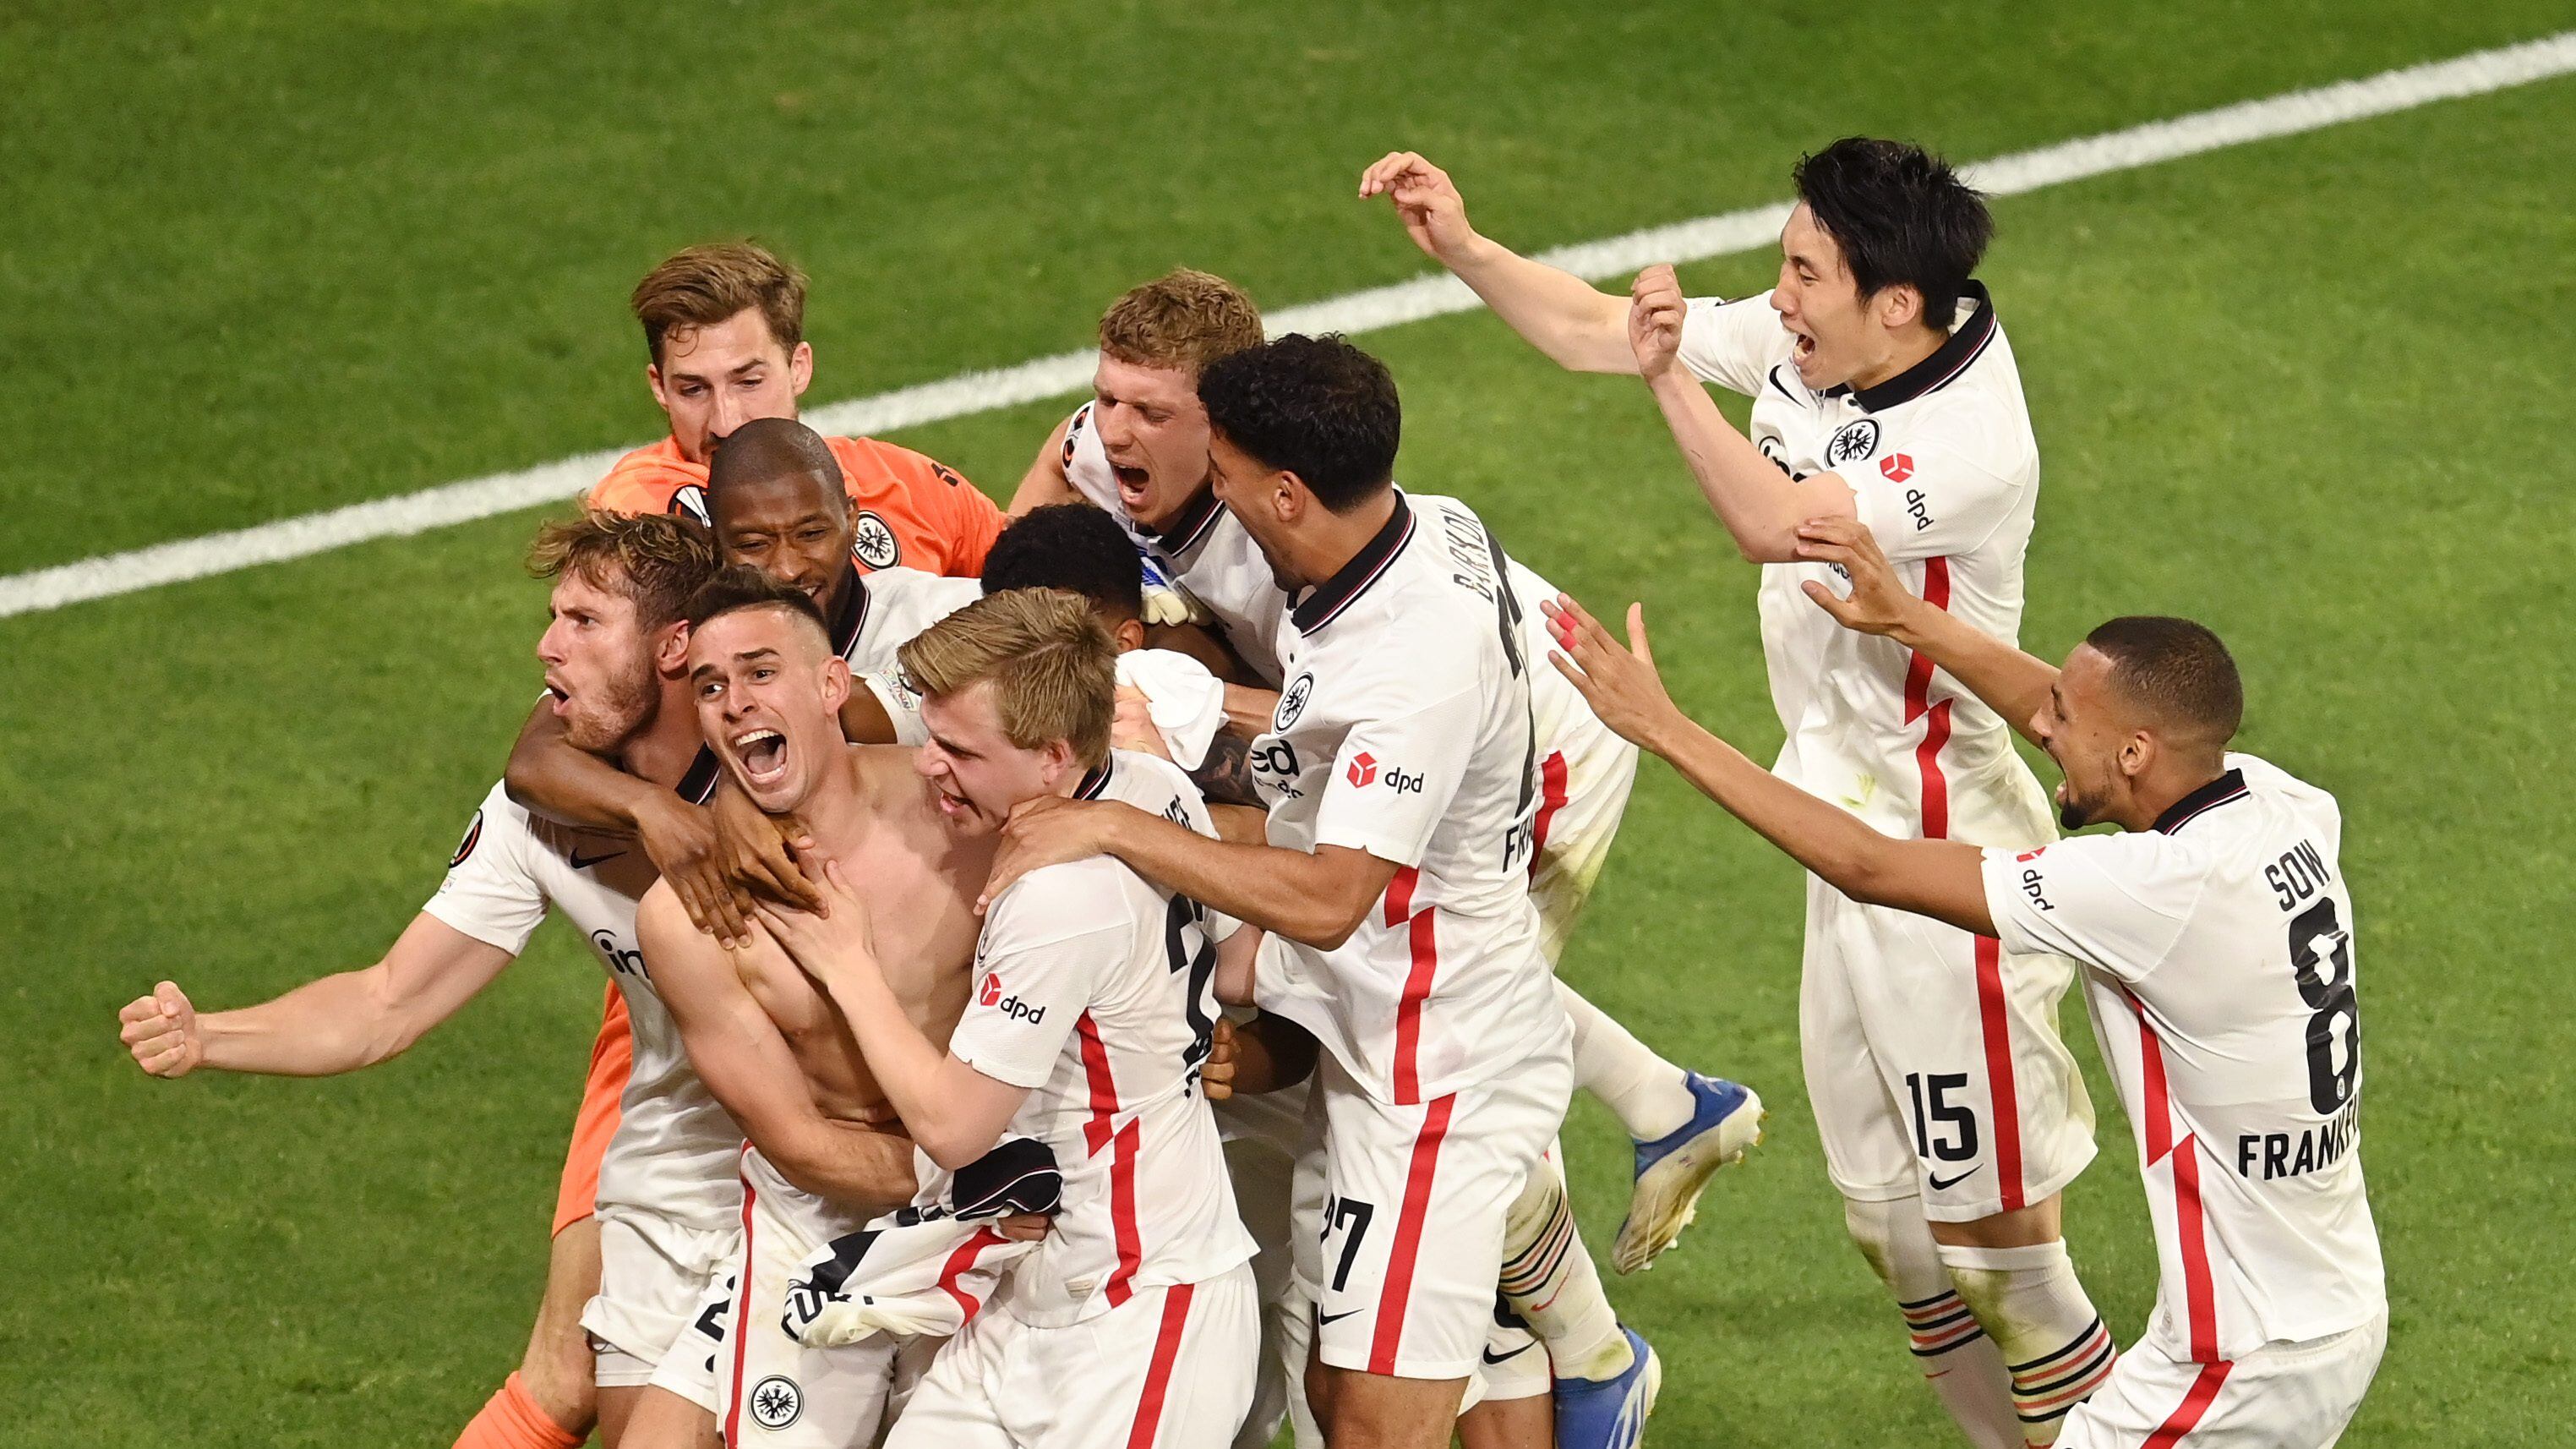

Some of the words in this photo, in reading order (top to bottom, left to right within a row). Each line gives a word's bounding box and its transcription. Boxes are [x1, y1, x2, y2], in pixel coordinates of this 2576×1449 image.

[1906, 489, 1935, 532] dpd
[1384, 766, 1425, 795] dpd
[2022, 869, 2055, 911] dpd
[2264, 838, 2331, 912] SOW
[1000, 995, 1046, 1025] dpd
[2289, 896, 2359, 1115] 8
[1905, 1072, 1978, 1162] 15
